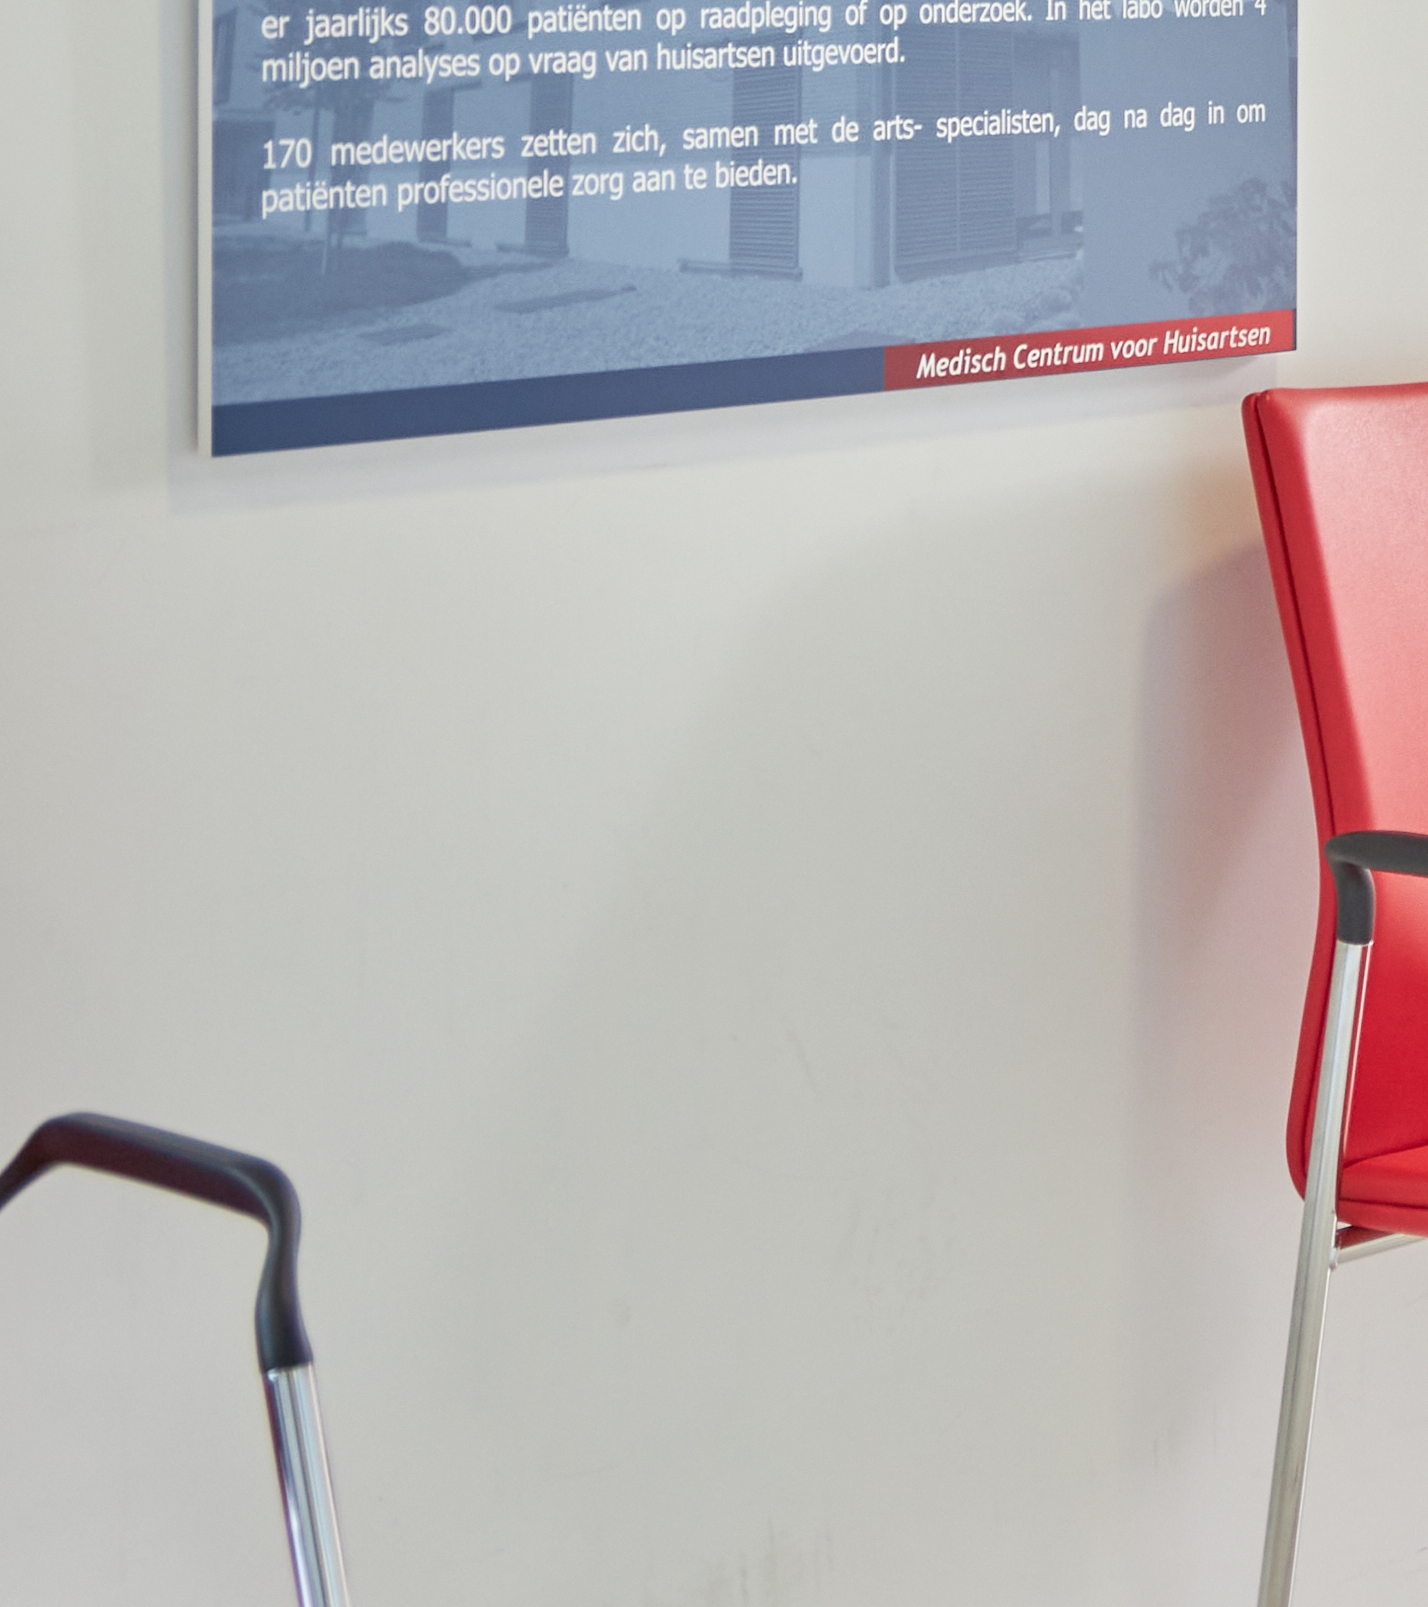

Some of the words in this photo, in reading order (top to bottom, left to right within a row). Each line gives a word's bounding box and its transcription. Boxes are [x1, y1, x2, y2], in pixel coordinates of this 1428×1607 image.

[262, 180, 387, 220] patiënten
[397, 168, 564, 213] professionele
[572, 172, 623, 201] zorg
[632, 169, 675, 193] aan
[683, 164, 707, 190] te
[715, 158, 797, 188] bieden.
[916, 345, 1006, 379] Medisch
[1013, 342, 1104, 369] Centrum
[1110, 337, 1158, 360] voor
[1163, 326, 1270, 355] Huisartsen
